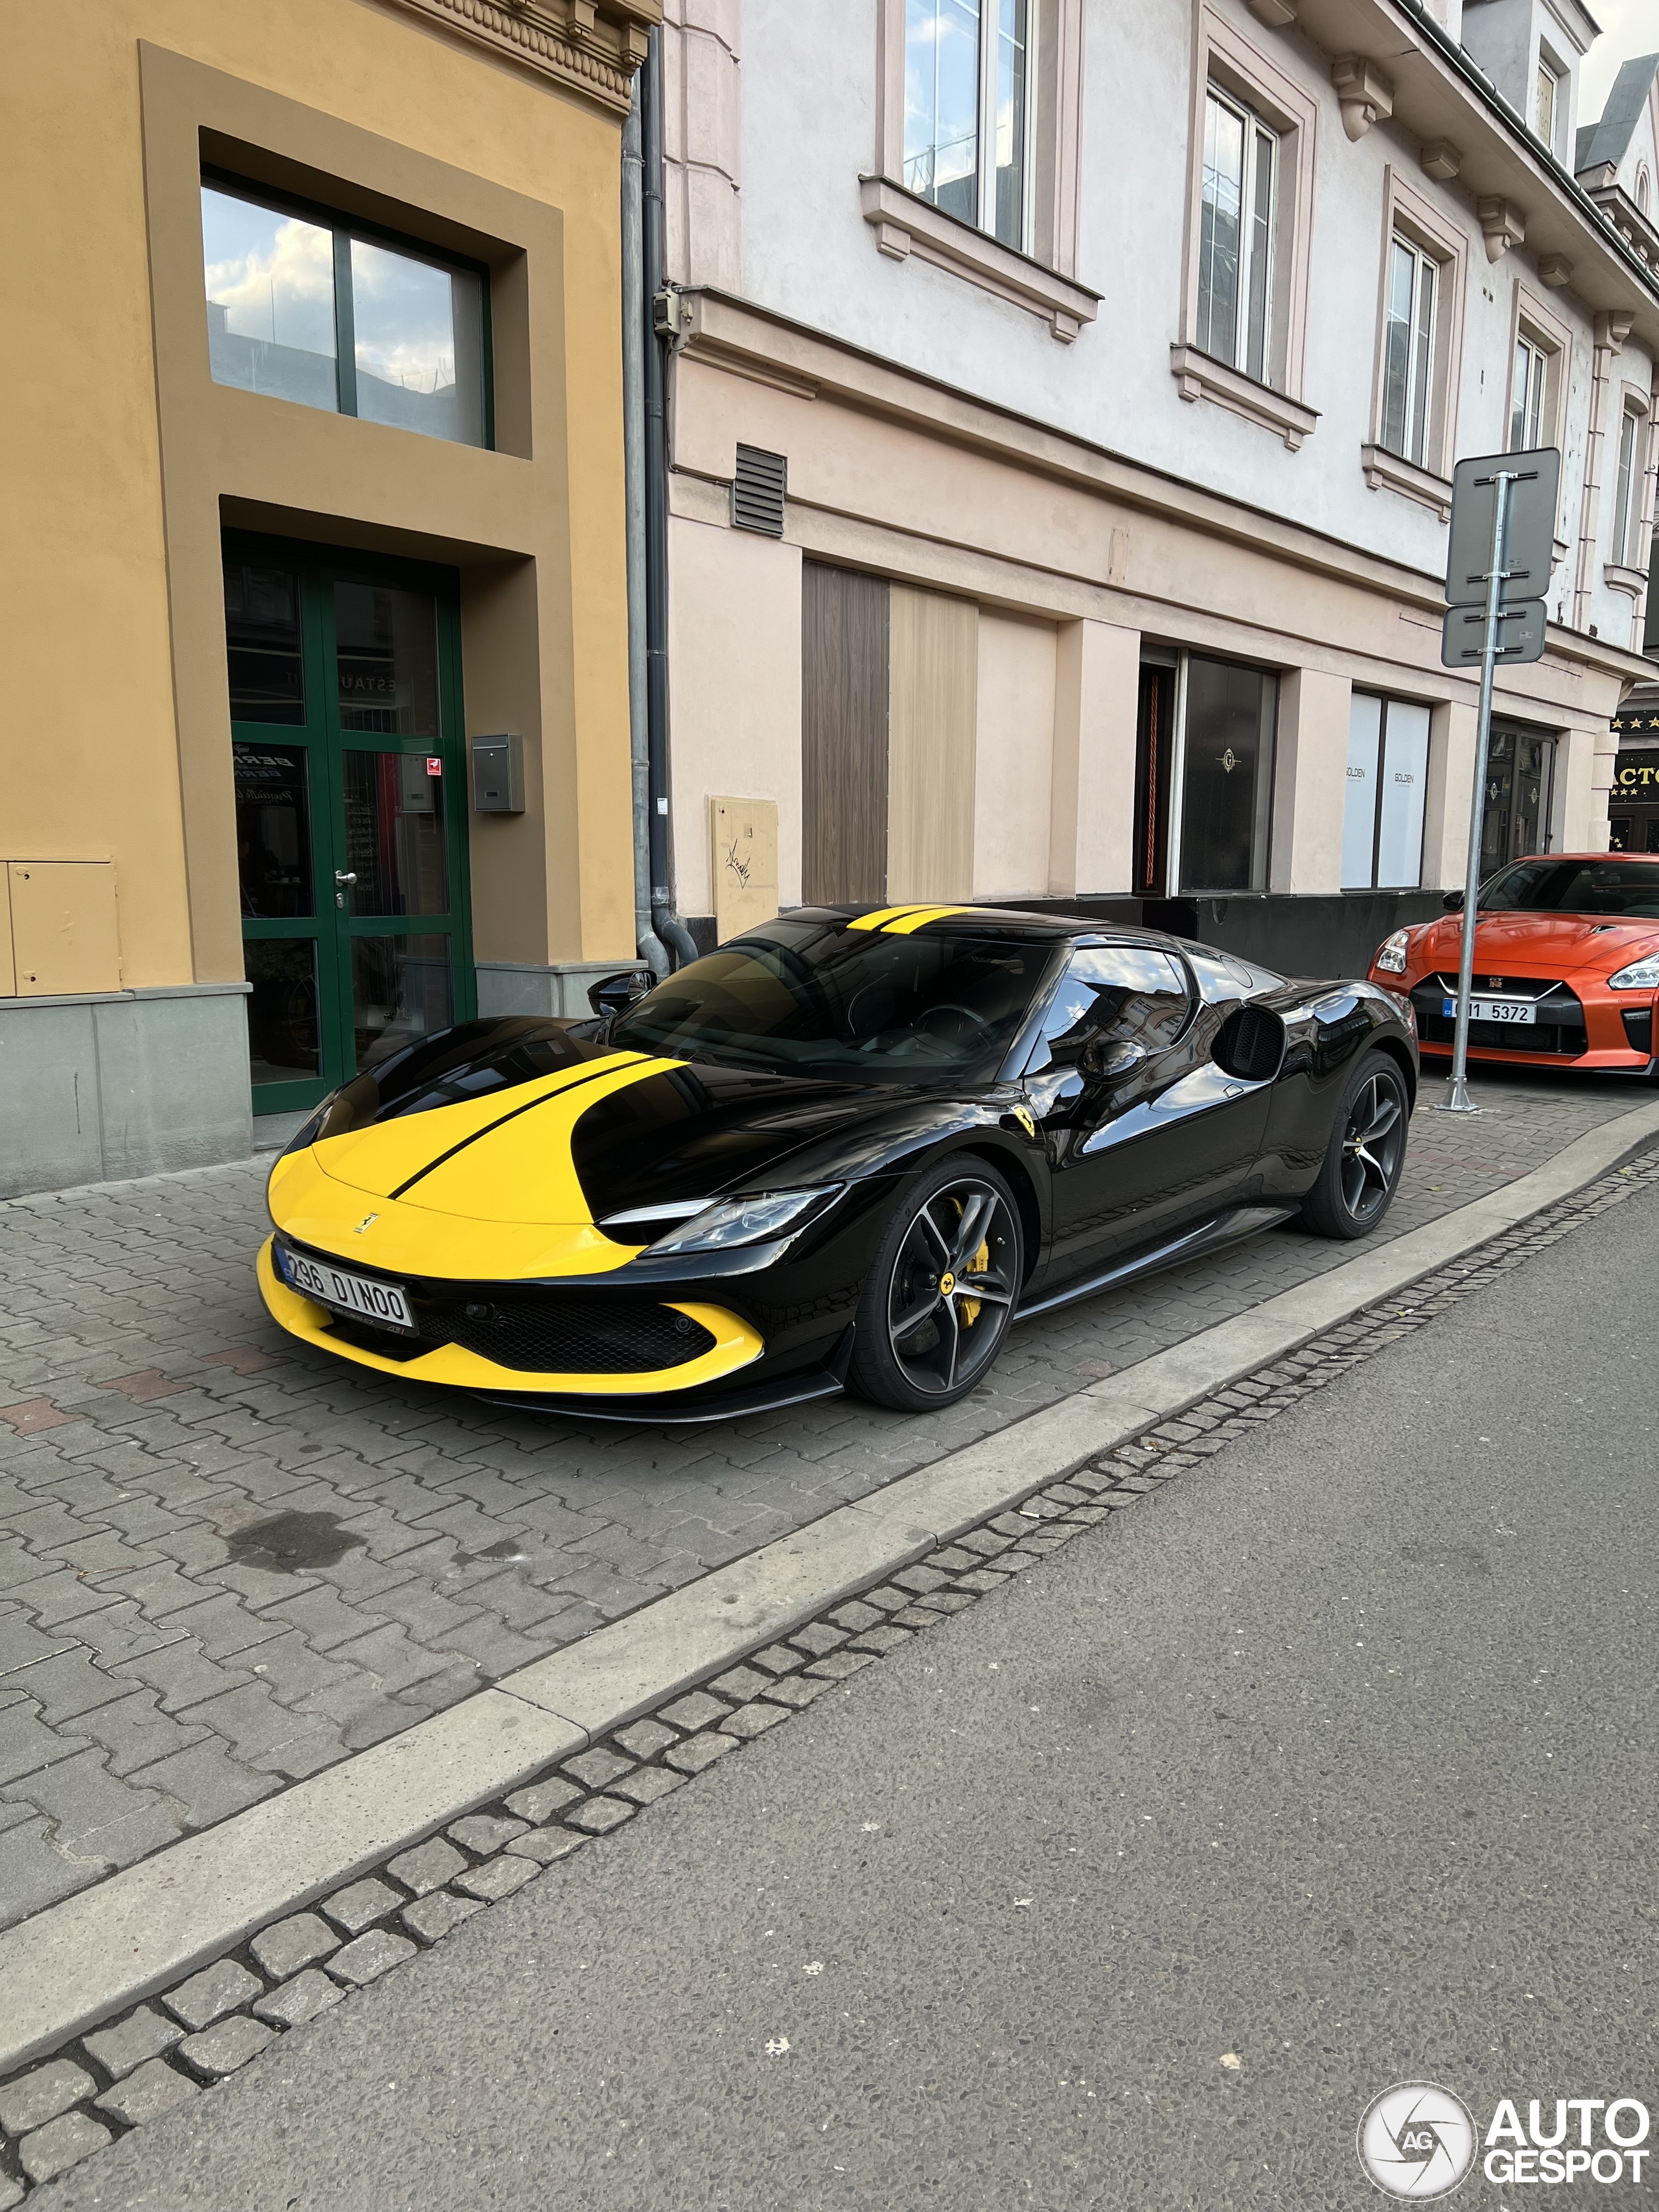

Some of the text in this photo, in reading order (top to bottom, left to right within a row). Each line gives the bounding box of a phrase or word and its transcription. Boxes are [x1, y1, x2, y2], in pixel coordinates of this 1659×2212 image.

[1395, 773, 1414, 784] GOLDEN
[1612, 767, 1659, 786] CT
[1492, 1005, 1528, 1021] 5372
[288, 1255, 325, 1293] 296
